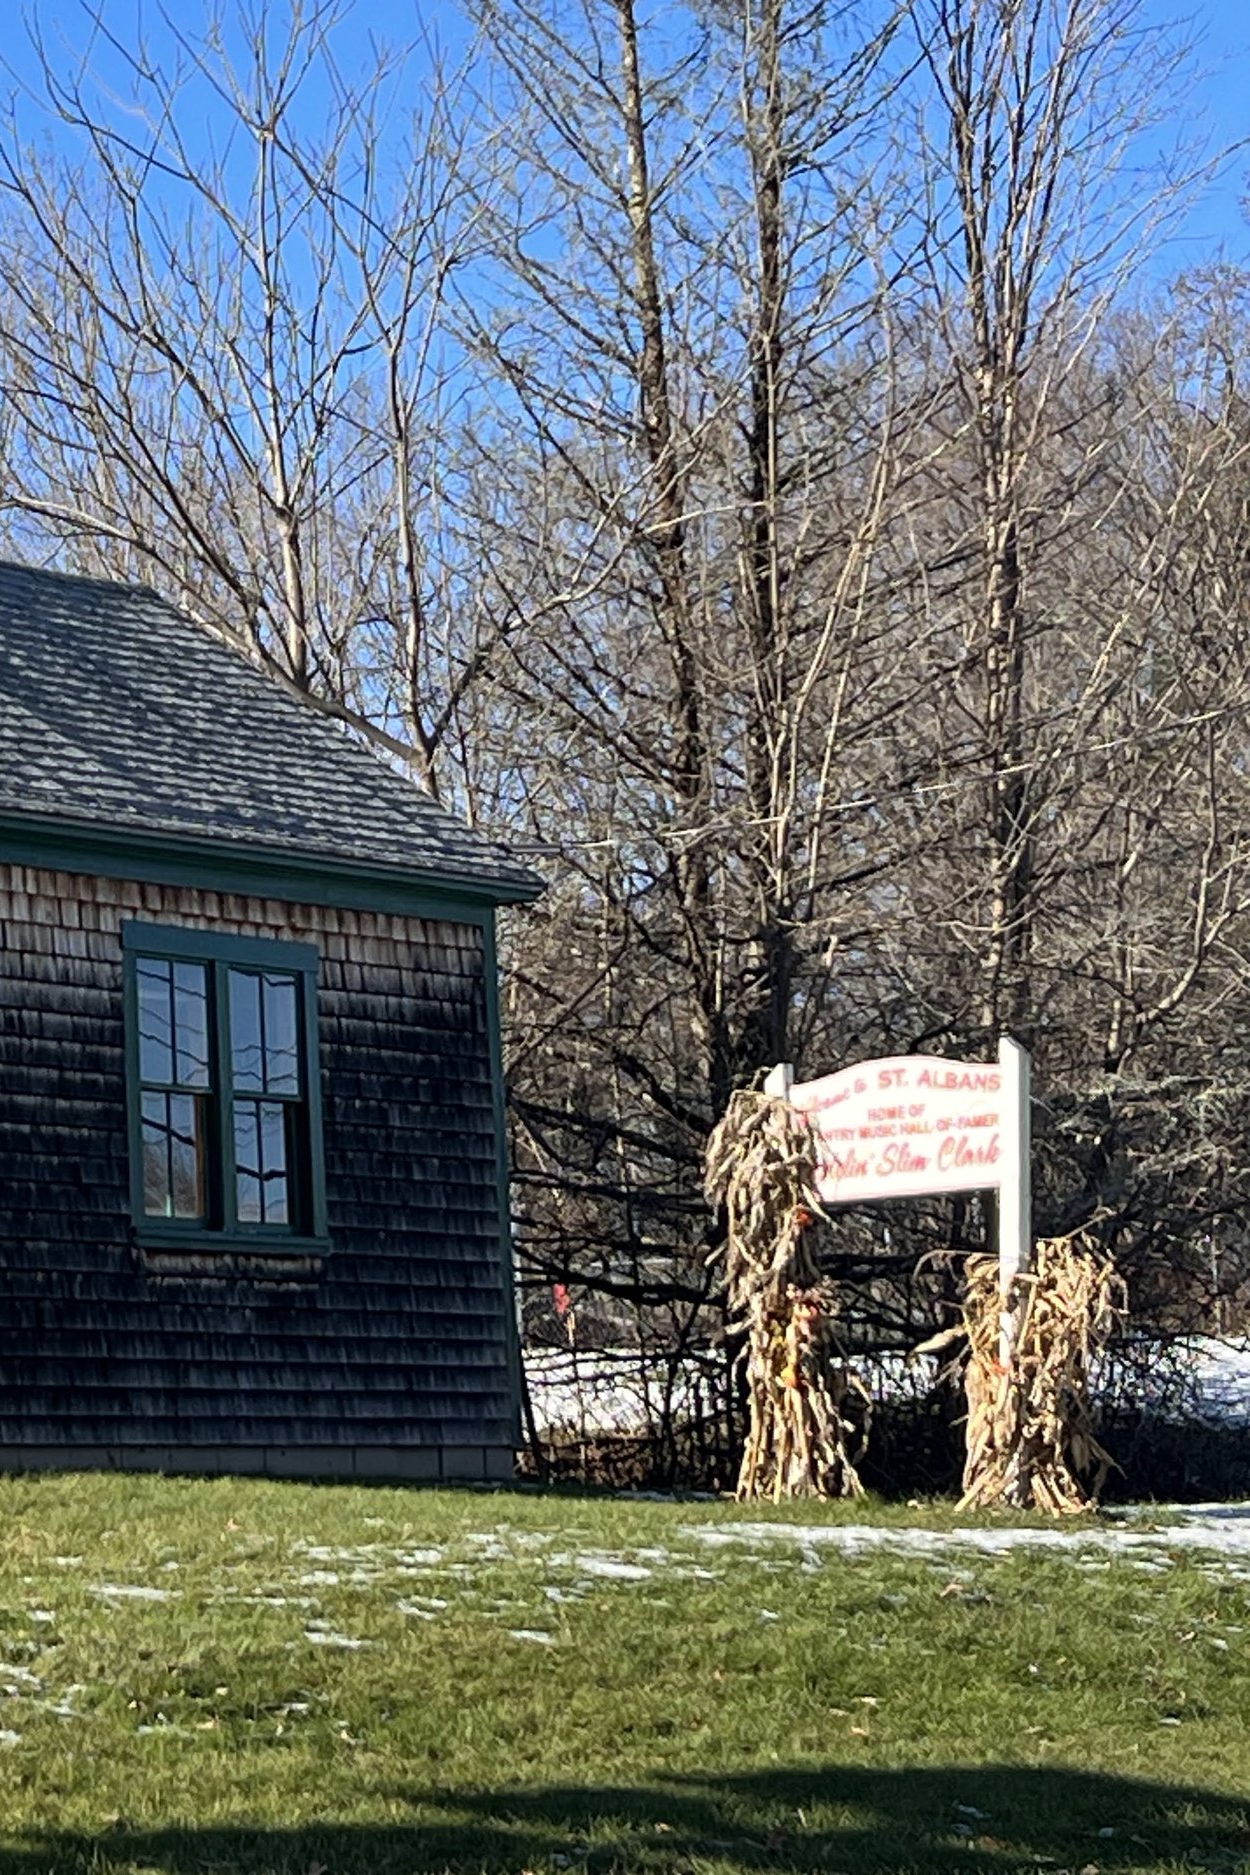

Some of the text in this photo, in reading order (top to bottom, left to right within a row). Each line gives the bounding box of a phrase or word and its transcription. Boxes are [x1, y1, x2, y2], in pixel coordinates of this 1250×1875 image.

[877, 1068, 910, 1090] ST.
[916, 1068, 1002, 1093] ALBANS
[867, 1103, 926, 1121] HOME OF
[822, 1128, 855, 1142] NTRY
[859, 1123, 898, 1139] MUSIC
[876, 1142, 931, 1176] Slim
[937, 1132, 1003, 1172] Clark
